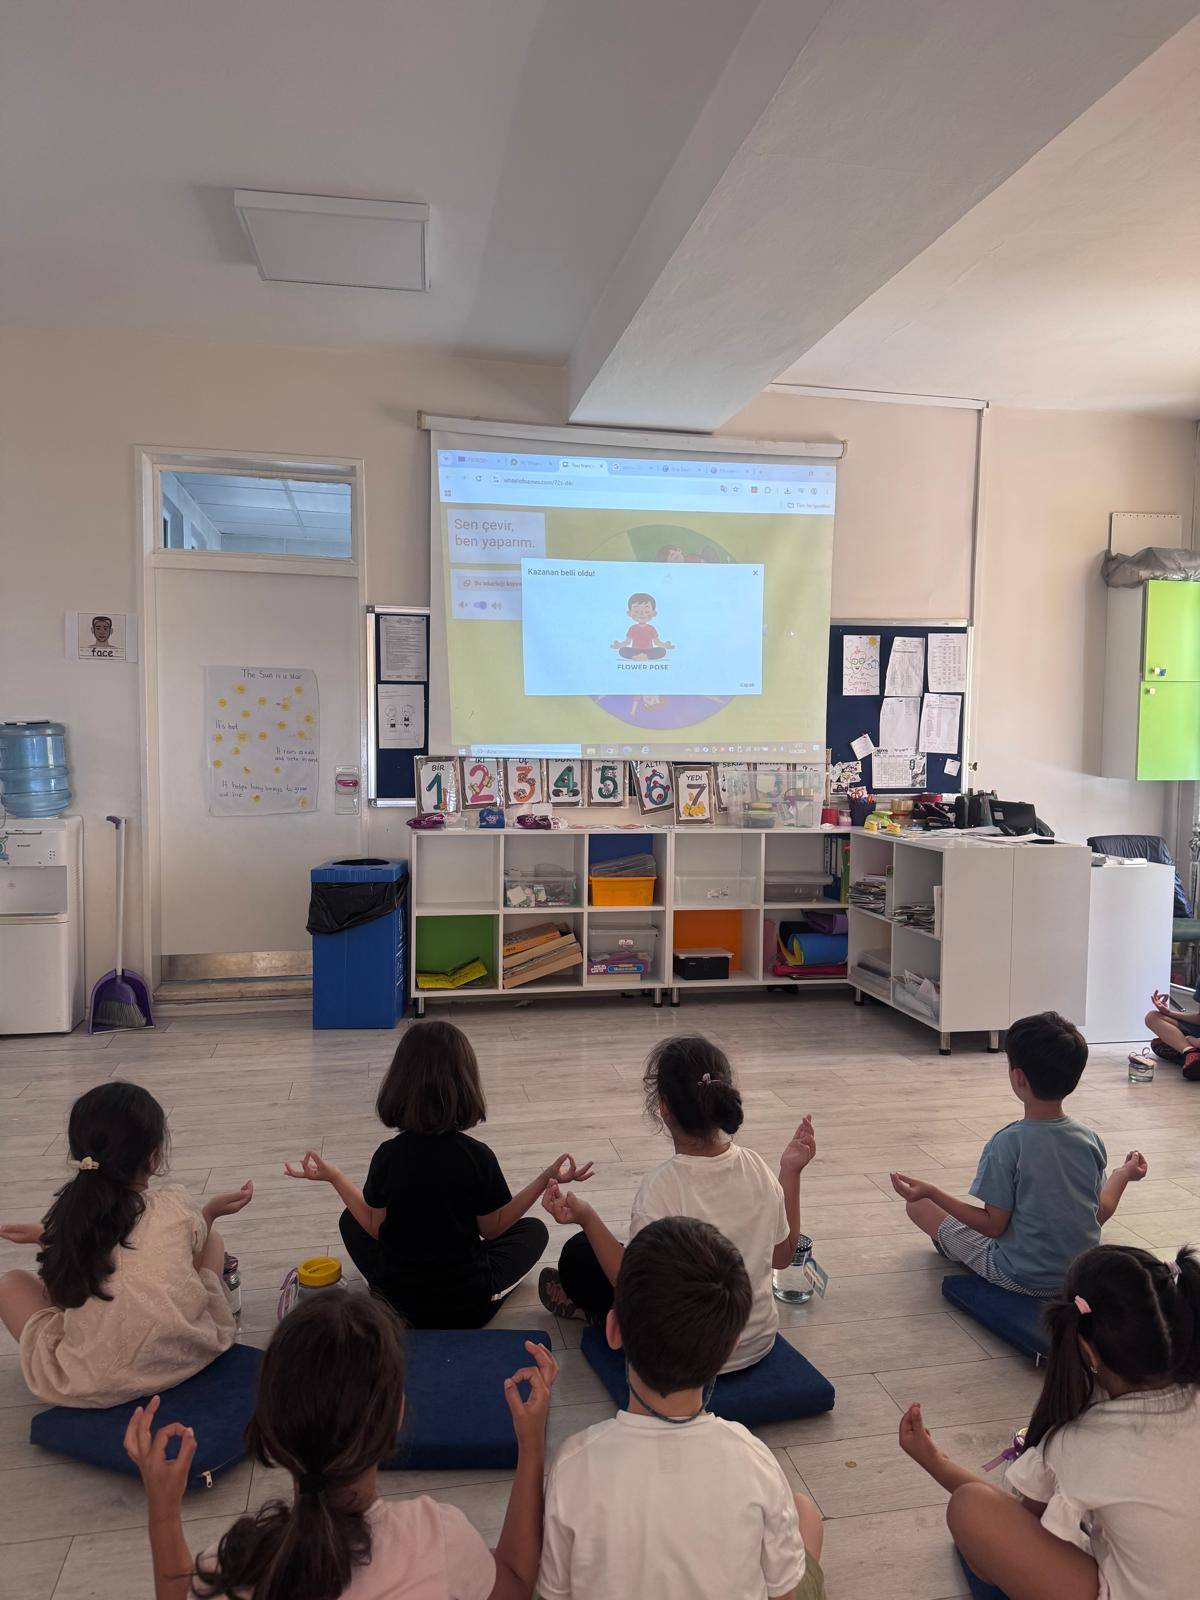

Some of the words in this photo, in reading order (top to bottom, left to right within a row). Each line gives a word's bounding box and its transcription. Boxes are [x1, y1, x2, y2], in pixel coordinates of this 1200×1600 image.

[454, 518, 479, 531] Sen
[482, 519, 515, 533] çevir,
[455, 534, 479, 547] ben
[528, 567, 559, 576] Kazanan
[560, 569, 576, 577] belli
[577, 569, 596, 577] oldu!
[91, 647, 114, 657] face
[241, 668, 256, 679] The
[259, 670, 273, 679] Sun
[469, 764, 495, 804] 2
[513, 765, 537, 803] 3
[553, 765, 580, 798] 4
[597, 765, 619, 799] 5
[646, 770, 670, 806] 6
[686, 773, 703, 782] YEDİ
[686, 783, 707, 813] 7
